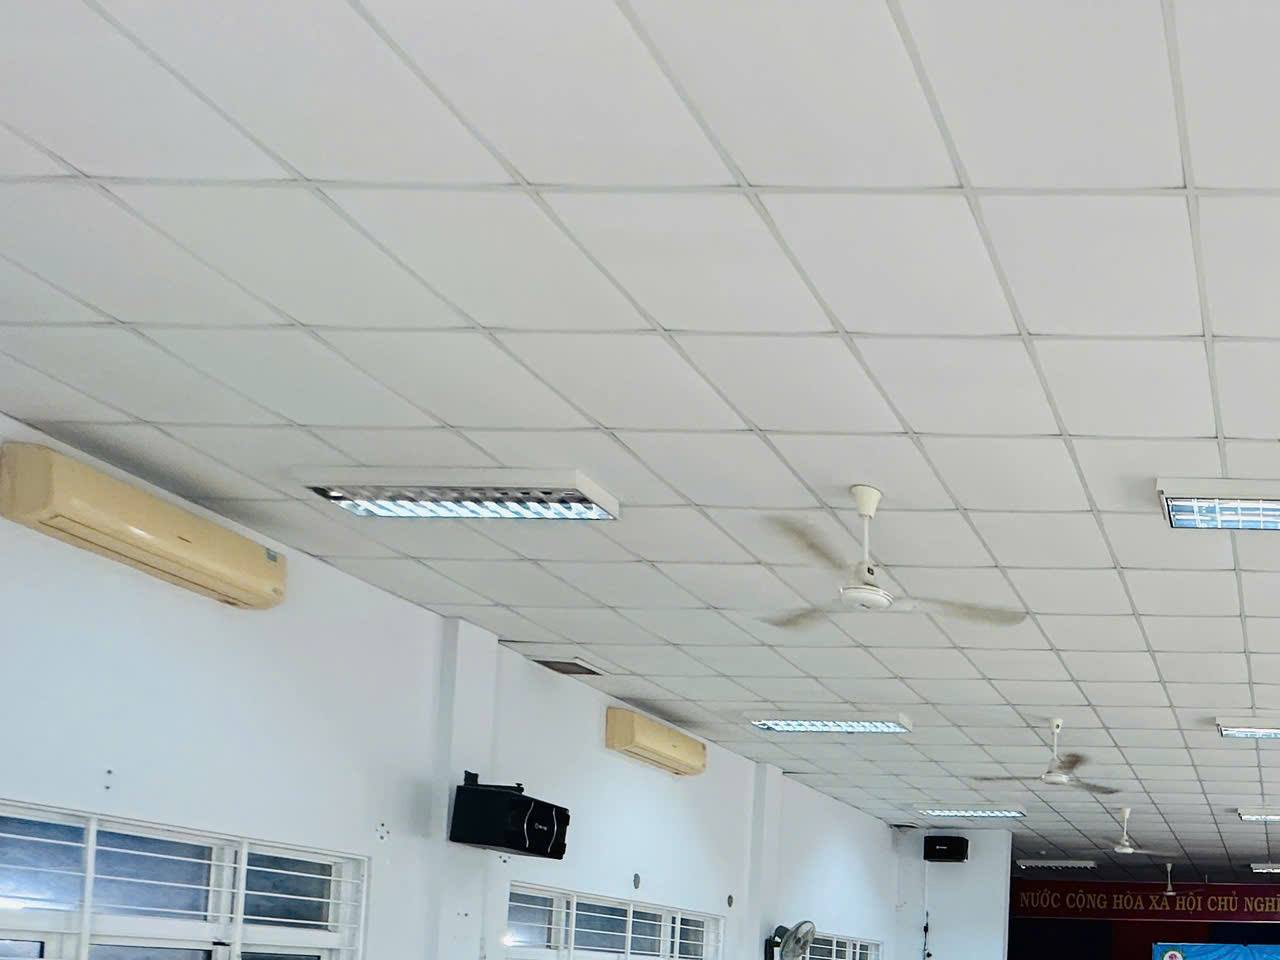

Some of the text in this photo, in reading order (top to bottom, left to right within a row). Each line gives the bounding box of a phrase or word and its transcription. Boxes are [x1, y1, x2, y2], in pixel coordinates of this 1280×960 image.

[1065, 889, 1107, 912] CỘNG
[1112, 891, 1144, 910] HÒA
[1175, 892, 1203, 914] HỘI
[1207, 890, 1239, 912] CHỦ
